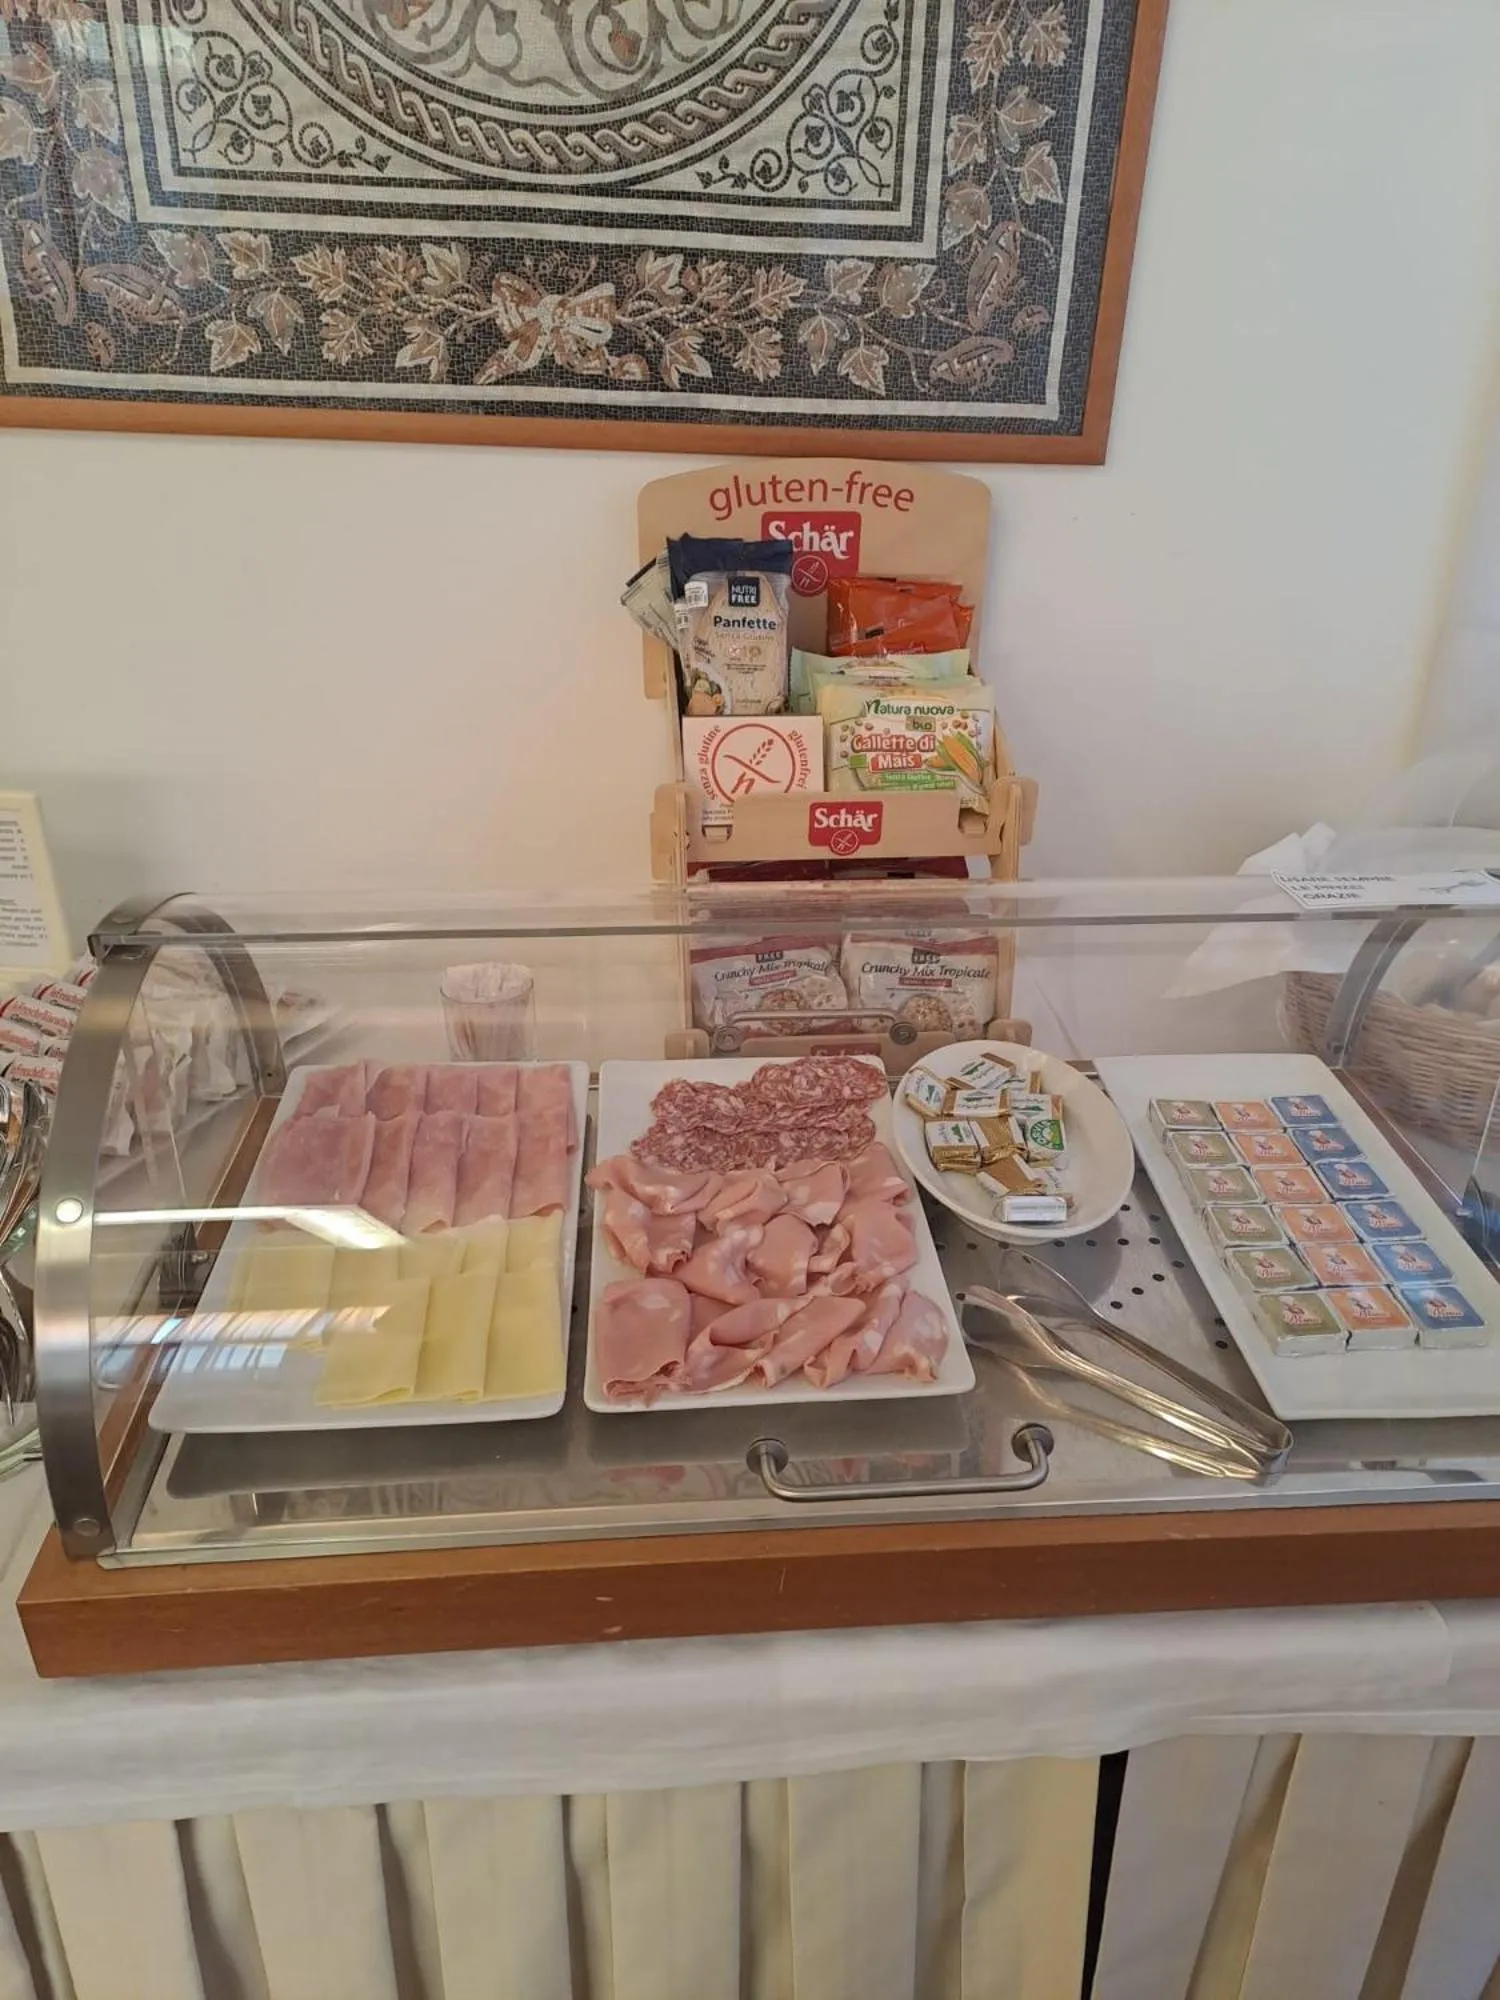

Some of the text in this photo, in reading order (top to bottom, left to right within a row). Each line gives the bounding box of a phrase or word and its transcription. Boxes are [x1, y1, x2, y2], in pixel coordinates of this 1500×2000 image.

[709, 471, 915, 521] gluten-free
[768, 520, 855, 560] Schär
[732, 594, 757, 604] FREE
[713, 615, 777, 630] Panfette
[914, 704, 954, 716] nuova
[697, 725, 721, 765] glutine
[852, 734, 936, 752] Gallette di
[788, 729, 811, 790] glutenfrei
[878, 754, 915, 770] Mais
[813, 807, 879, 832] Schär
[713, 967, 756, 983] Crunchy
[861, 962, 910, 977] Crunchy
[938, 964, 991, 979] Tropicale
